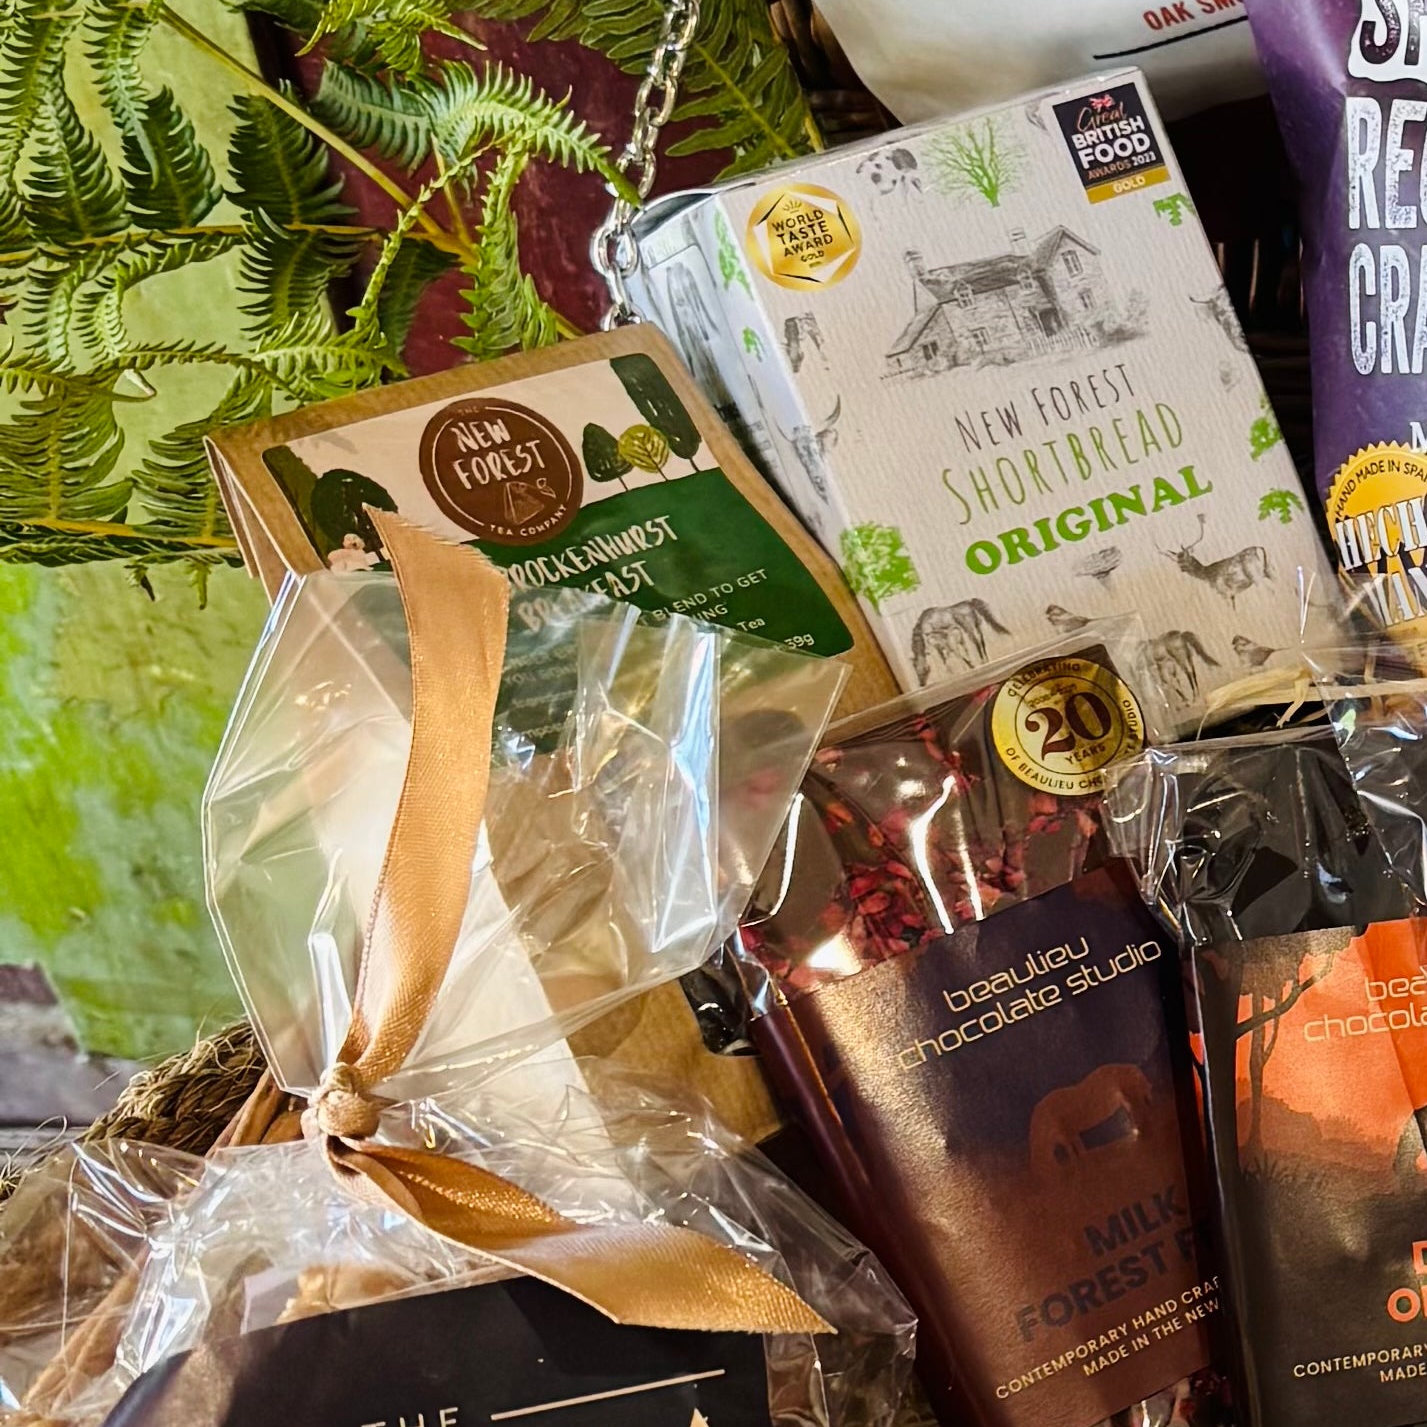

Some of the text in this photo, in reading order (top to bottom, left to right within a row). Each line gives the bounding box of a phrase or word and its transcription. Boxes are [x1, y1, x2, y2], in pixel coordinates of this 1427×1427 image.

[772, 206, 824, 235] WORLD
[777, 219, 830, 246] TASTE
[780, 232, 834, 258] AWARD
[954, 363, 1137, 451] NEW FOREST
[942, 403, 1184, 525] SHORTBREAD
[963, 464, 1213, 574] ORIGINAL
[899, 936, 1162, 1070] chocolate studio
[942, 934, 1090, 1014] beaulieu
